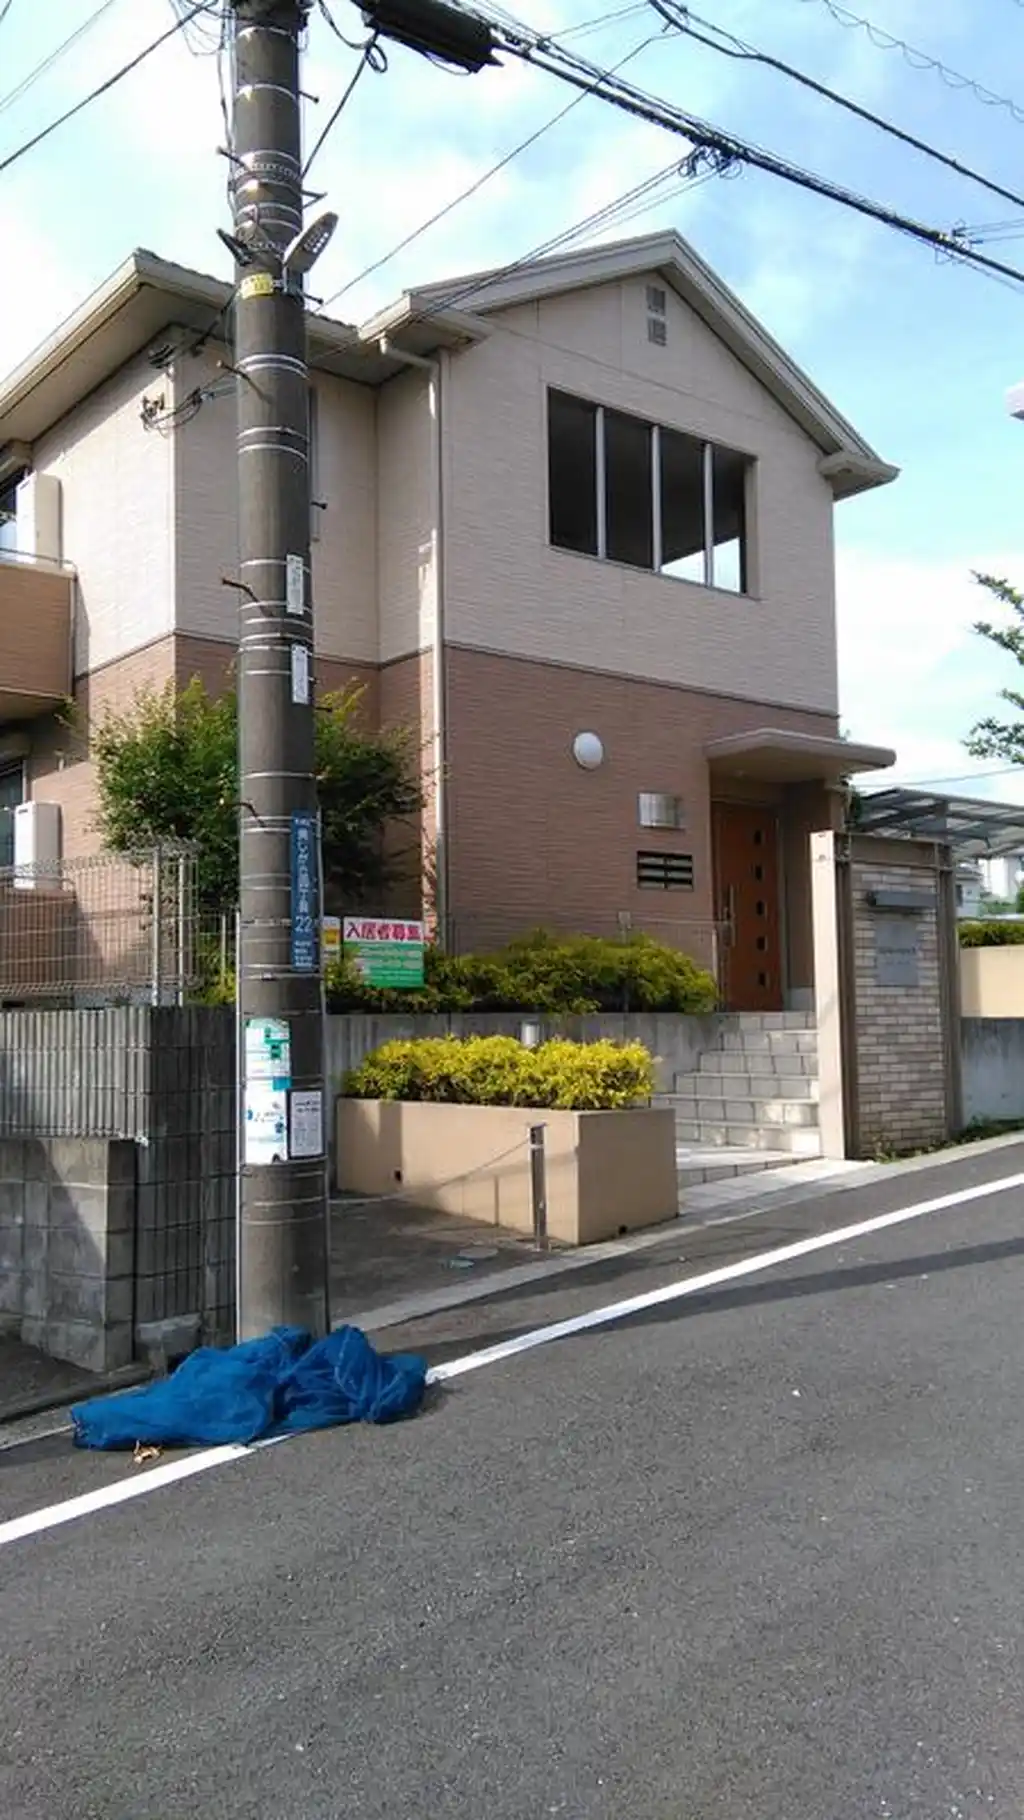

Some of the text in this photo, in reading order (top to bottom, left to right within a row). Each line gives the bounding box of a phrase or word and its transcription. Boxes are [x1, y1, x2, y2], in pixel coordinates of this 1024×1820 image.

[295, 915, 313, 933] 22
[346, 920, 421, 941] 入居者募集
